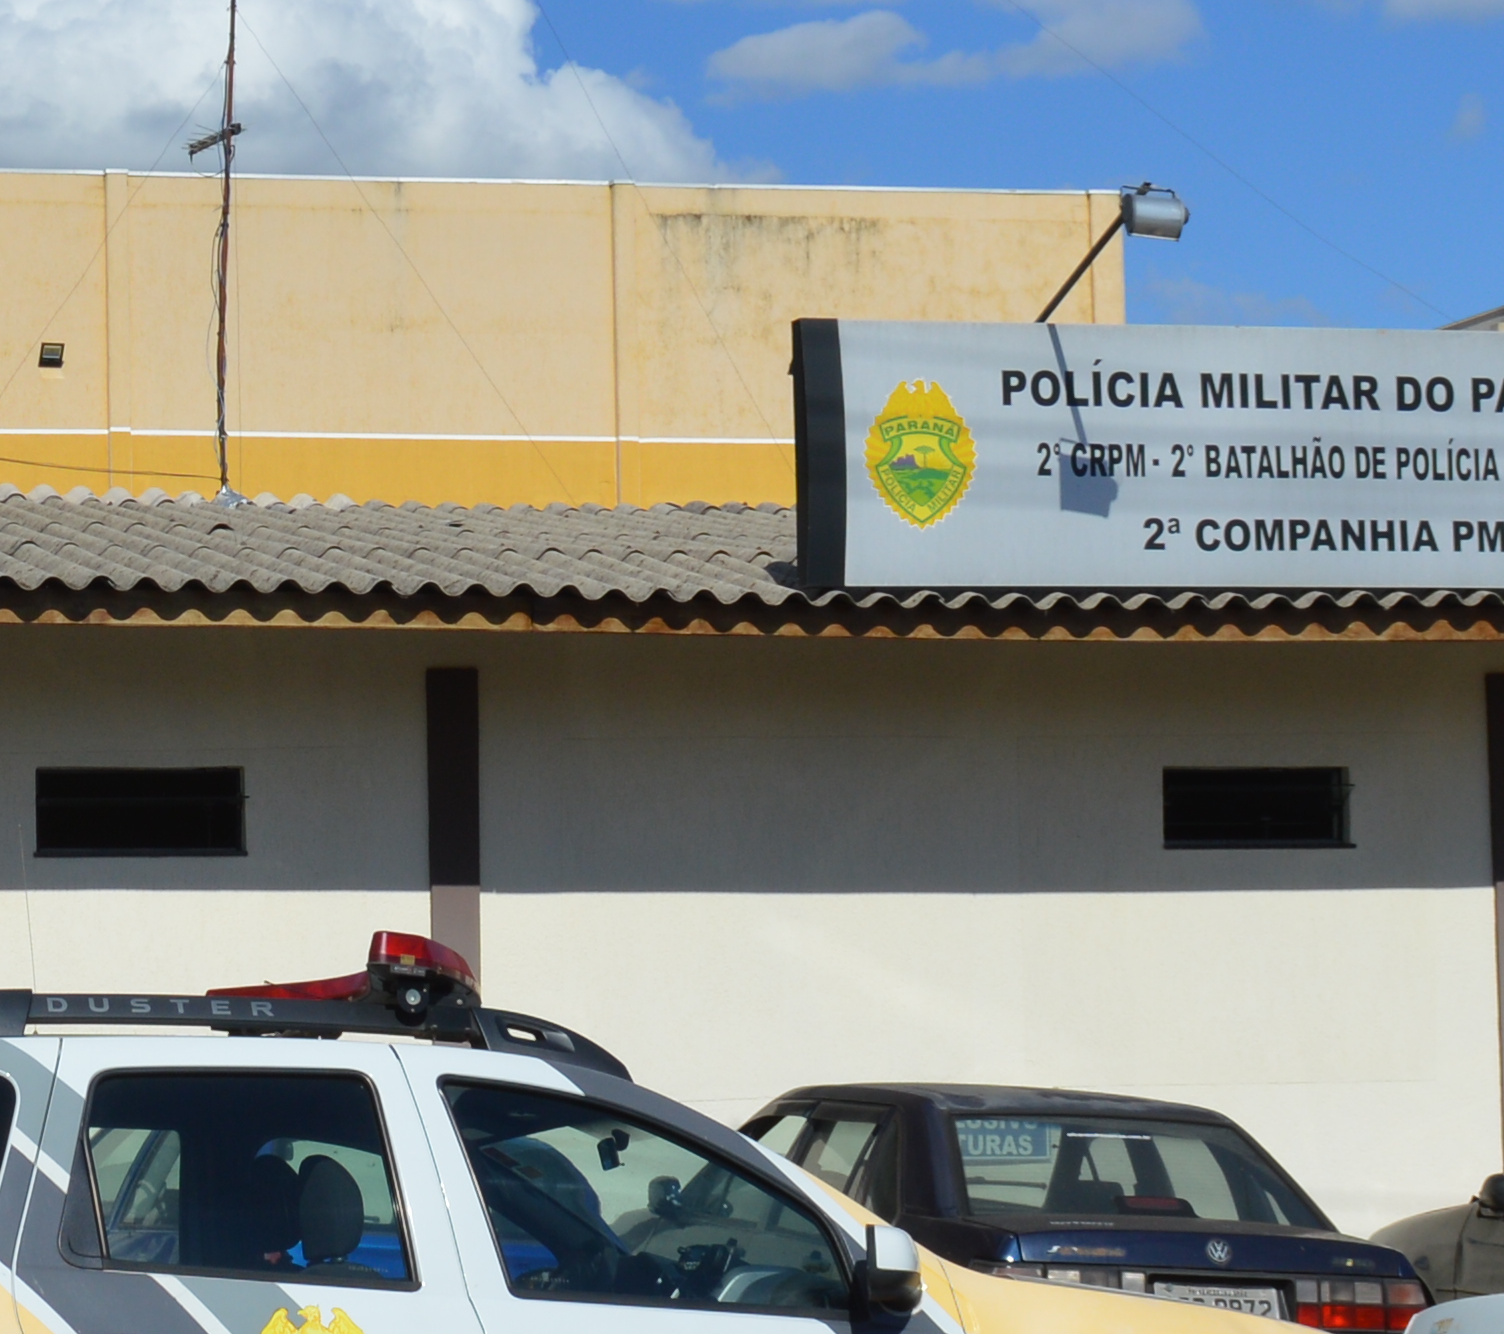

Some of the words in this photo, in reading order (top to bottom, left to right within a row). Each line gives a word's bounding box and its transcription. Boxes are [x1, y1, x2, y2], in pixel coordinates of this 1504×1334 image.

[1002, 359, 1183, 408] POLÍCIA
[1200, 372, 1380, 411] MILITAR
[1396, 375, 1455, 413] DO
[884, 420, 956, 438] PARANÁ
[1070, 443, 1146, 478] CRPM
[1204, 436, 1345, 480] BATALHÃO
[1354, 446, 1387, 480] DE
[1396, 438, 1500, 482] POLÍCIA
[1195, 518, 1439, 552] COMPANHIA
[46, 997, 275, 1016] DUSTER
